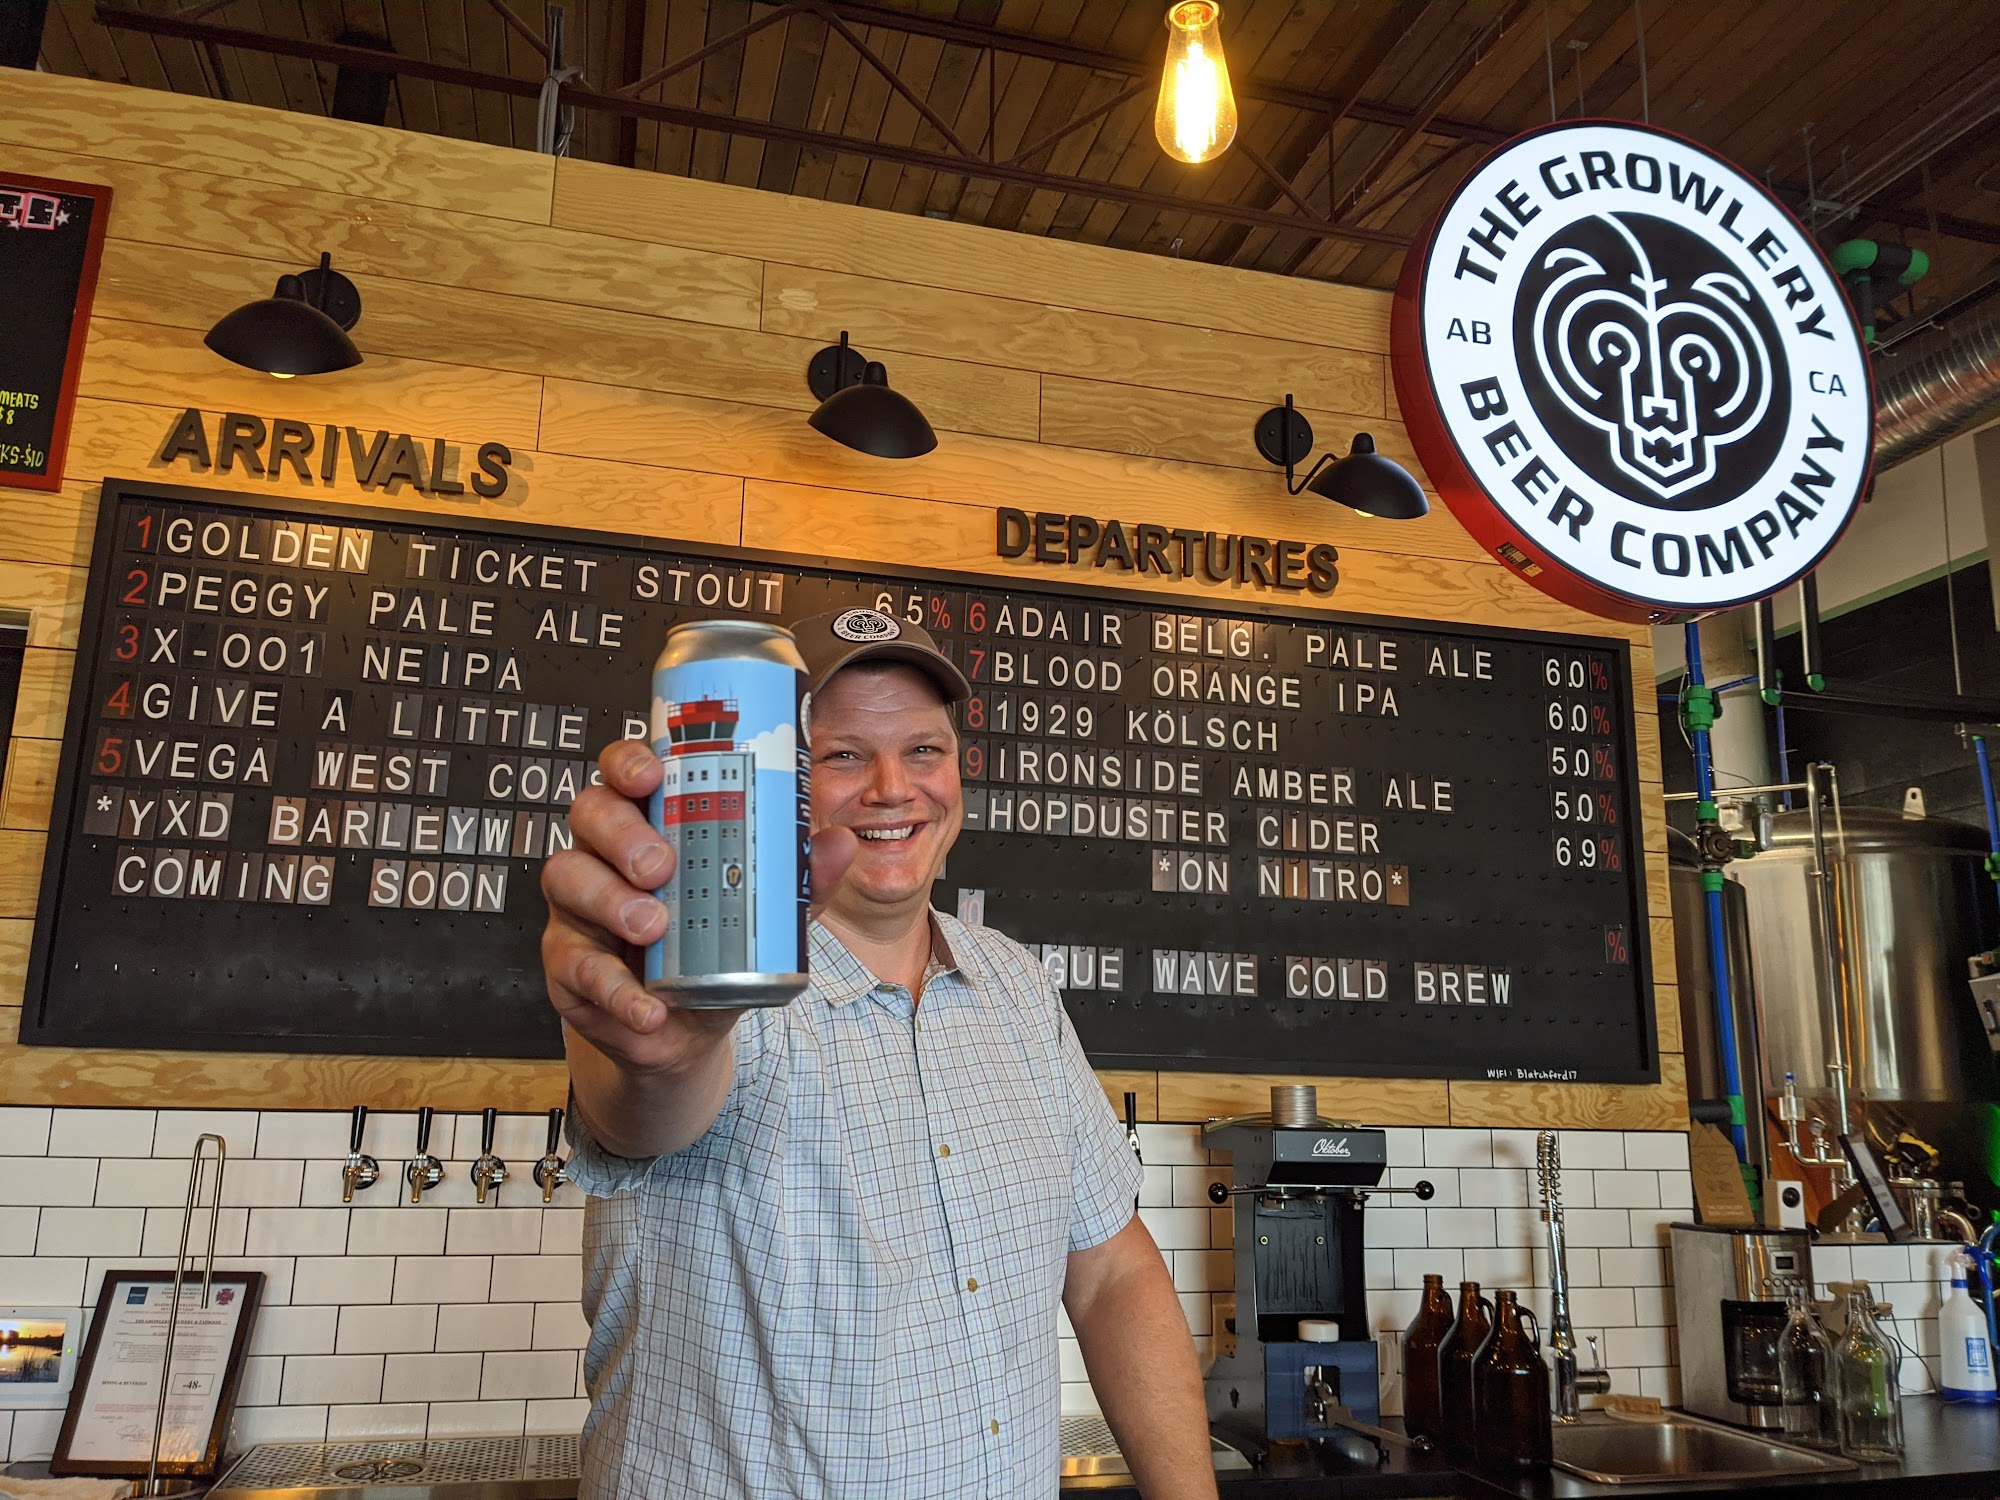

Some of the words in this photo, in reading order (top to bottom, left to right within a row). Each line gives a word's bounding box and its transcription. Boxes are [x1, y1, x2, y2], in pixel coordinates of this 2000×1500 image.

[1454, 179, 1542, 285] THE
[1539, 150, 1835, 343] GROWLERY
[1446, 317, 1492, 345] AB
[1809, 370, 1847, 397] CA
[160, 407, 512, 498] ARRIVALS
[1460, 376, 1595, 543] BEER
[1610, 413, 1845, 578] COMPANY
[138, 516, 151, 548] 1
[166, 517, 369, 572] GOLDEN
[412, 543, 598, 594] TICKET
[636, 565, 780, 613] STOUT
[997, 506, 1339, 592] DEPARTURES
[124, 570, 148, 604] 2
[159, 572, 328, 619] PEGGY
[370, 592, 494, 635] PALE
[536, 609, 622, 647] ALE
[970, 602, 986, 632] 6
[996, 605, 1122, 644] ADAIR
[1307, 635, 1397, 670] PALE
[1429, 648, 1492, 679] ALE
[117, 625, 139, 659] 3
[363, 645, 521, 690] NEIPA
[970, 650, 985, 678] 7
[995, 652, 1121, 690] BLOOD
[1154, 667, 1299, 707] ORANGE
[1339, 684, 1398, 716] IPA
[108, 682, 129, 715] 4
[143, 683, 277, 726] GIVE
[322, 697, 345, 731] A
[393, 702, 582, 748] LITTLE
[968, 698, 984, 728] 8
[996, 701, 1092, 736] 1929
[1128, 709, 1277, 752] KÖLSCH
[98, 738, 122, 774] 5
[136, 740, 268, 782] VEGA
[319, 751, 446, 792] WEST
[966, 747, 983, 777] 9
[1000, 749, 1199, 793] IRONSIDE
[1234, 767, 1353, 804] AMBER
[1386, 779, 1451, 811] ALE
[1260, 816, 1379, 853] CIDER
[119, 856, 329, 901] COMING
[374, 869, 503, 909] SOON
[1045, 952, 1120, 989] GUE
[1156, 958, 1254, 993] WAVE
[1289, 965, 1386, 998] COLD
[1418, 971, 1509, 1004] BREW
[1311, 1137, 1351, 1157] Oktober
